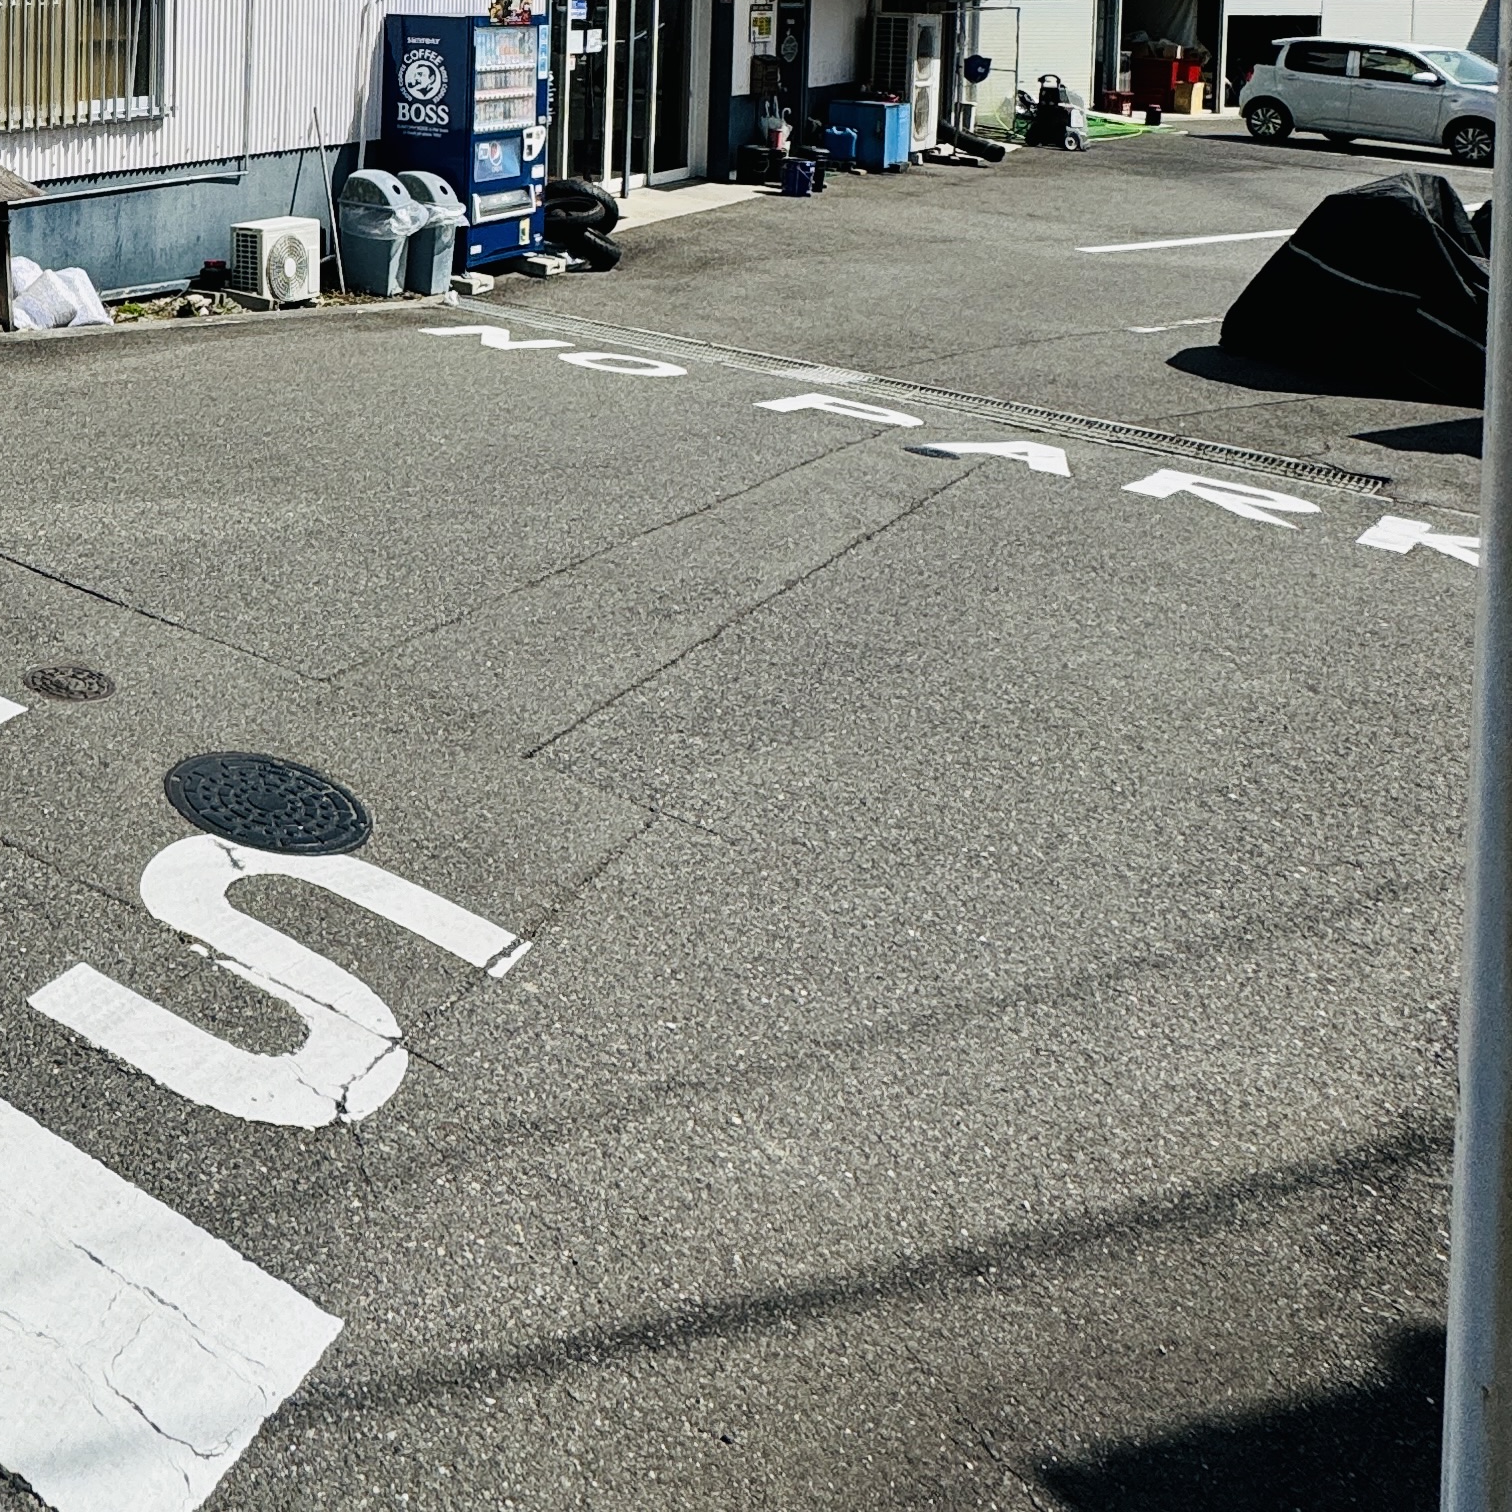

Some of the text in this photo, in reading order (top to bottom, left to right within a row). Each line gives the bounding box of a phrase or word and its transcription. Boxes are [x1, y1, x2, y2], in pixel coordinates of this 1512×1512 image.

[403, 48, 445, 66] COFFEE
[396, 101, 450, 126] BOSS
[418, 324, 688, 378] NO
